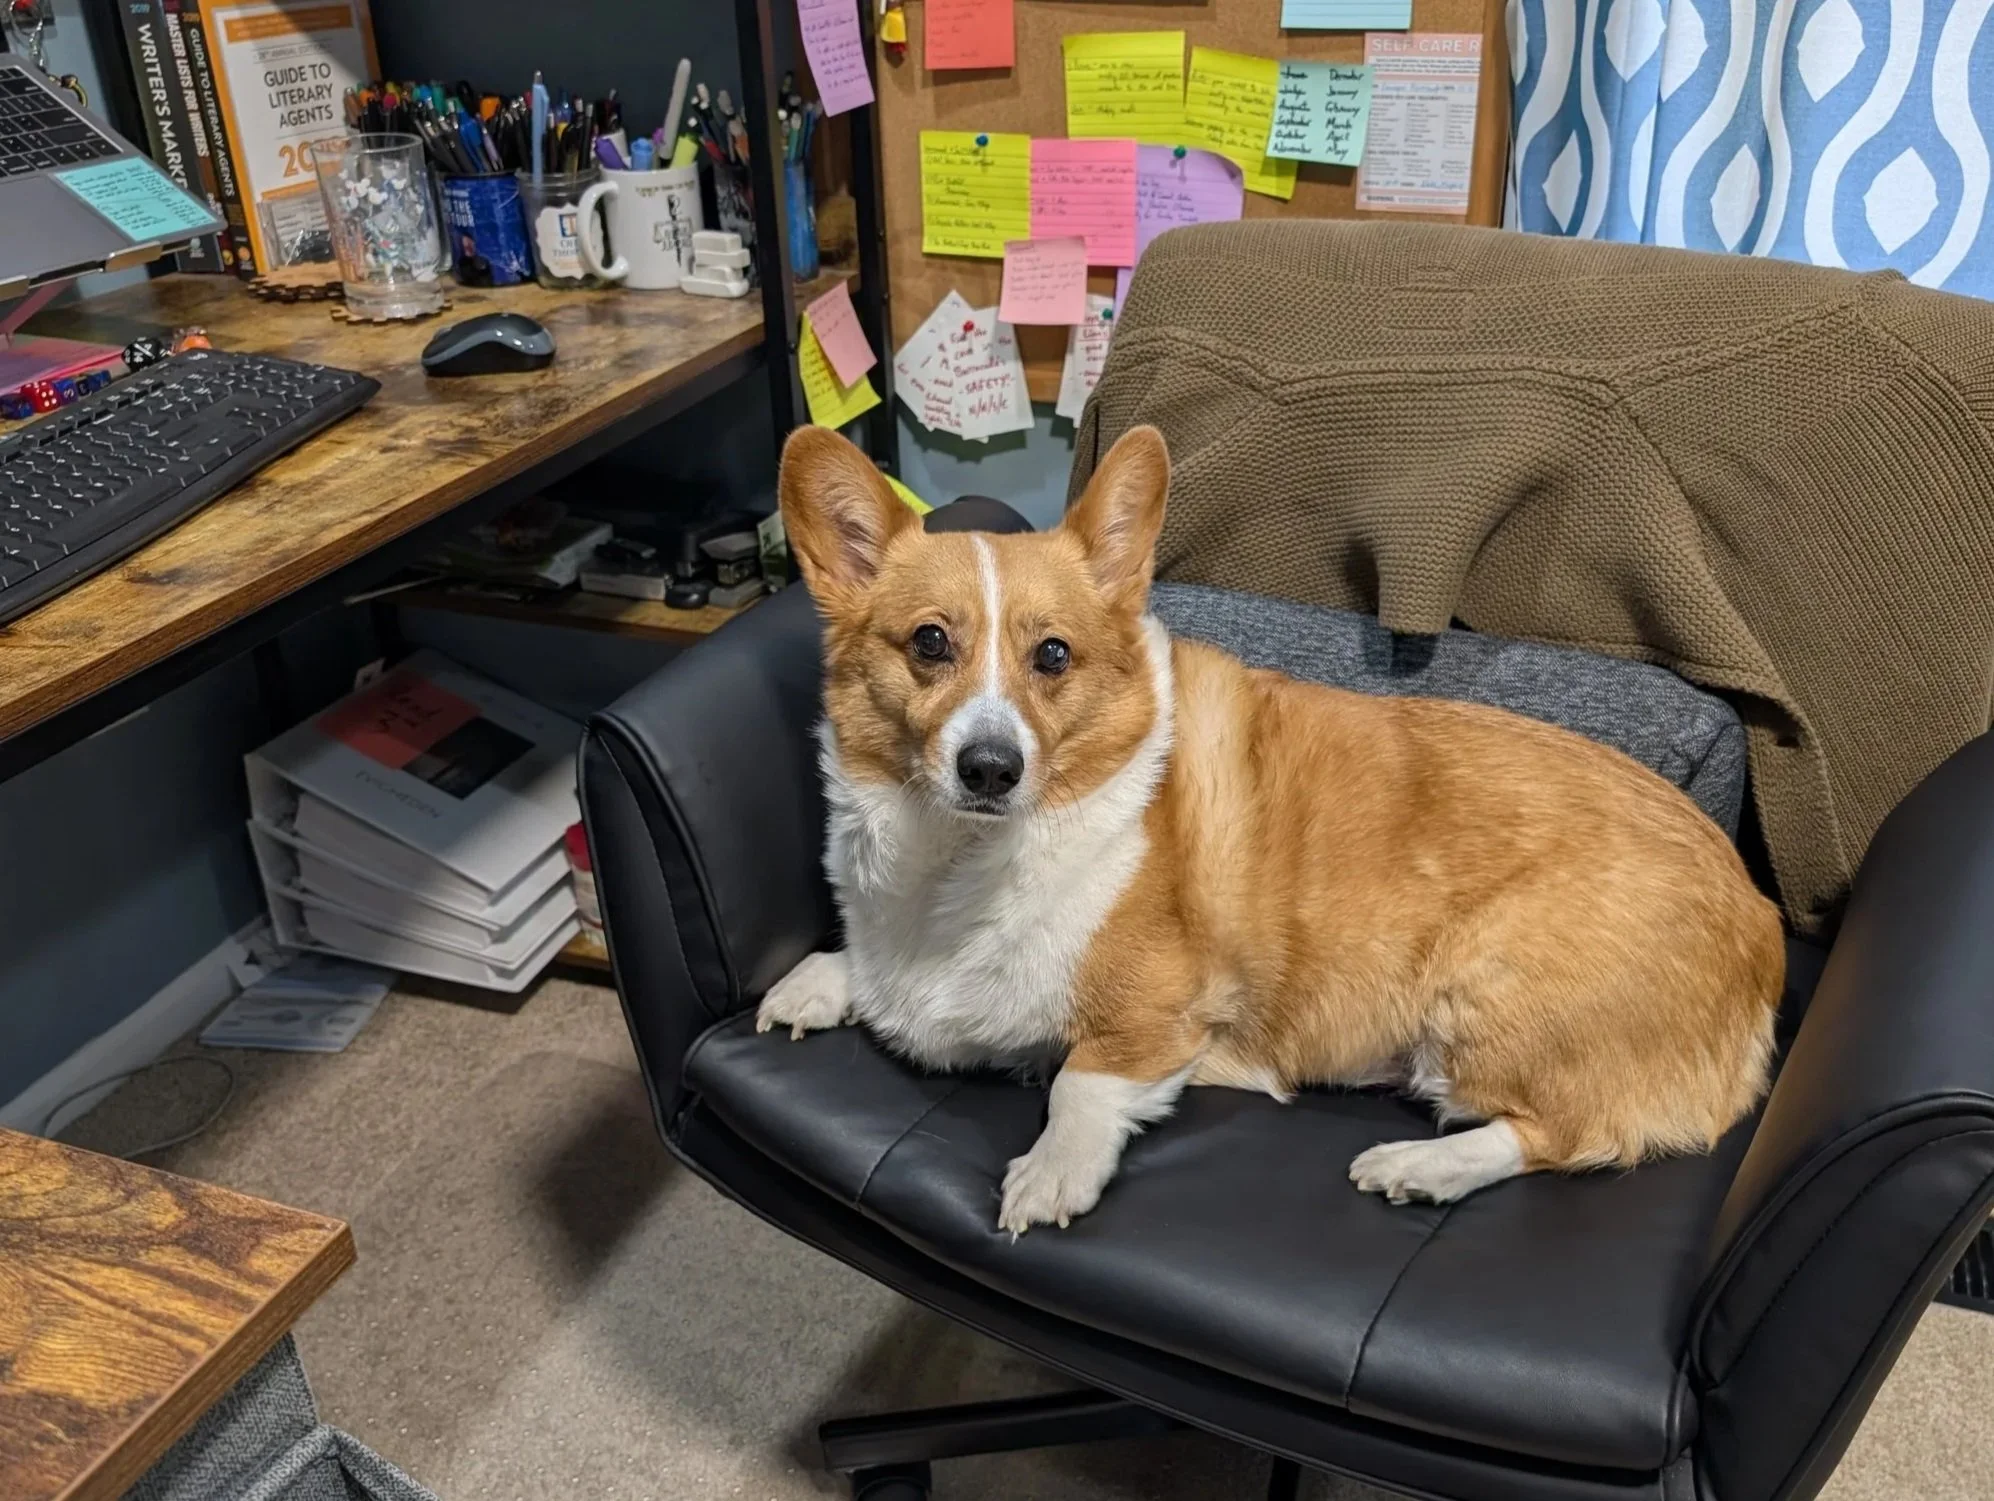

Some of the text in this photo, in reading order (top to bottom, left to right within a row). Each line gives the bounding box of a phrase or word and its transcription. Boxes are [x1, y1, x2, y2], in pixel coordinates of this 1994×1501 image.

[165, 13, 187, 58] MASTER
[190, 28, 207, 68] GUIDE
[1372, 38, 1413, 52] SELF
[1419, 39, 1464, 53] CARE
[137, 22, 172, 117] WRITER'S
[176, 59, 194, 89] LISTS
[200, 71, 212, 89] TO
[263, 62, 332, 88] GUIDE TO
[183, 89, 199, 111] FOR
[268, 83, 334, 109] LITERARY
[203, 90, 225, 147] LITERARY
[279, 104, 334, 129] AGENTS
[216, 149, 235, 197] AGENTS
